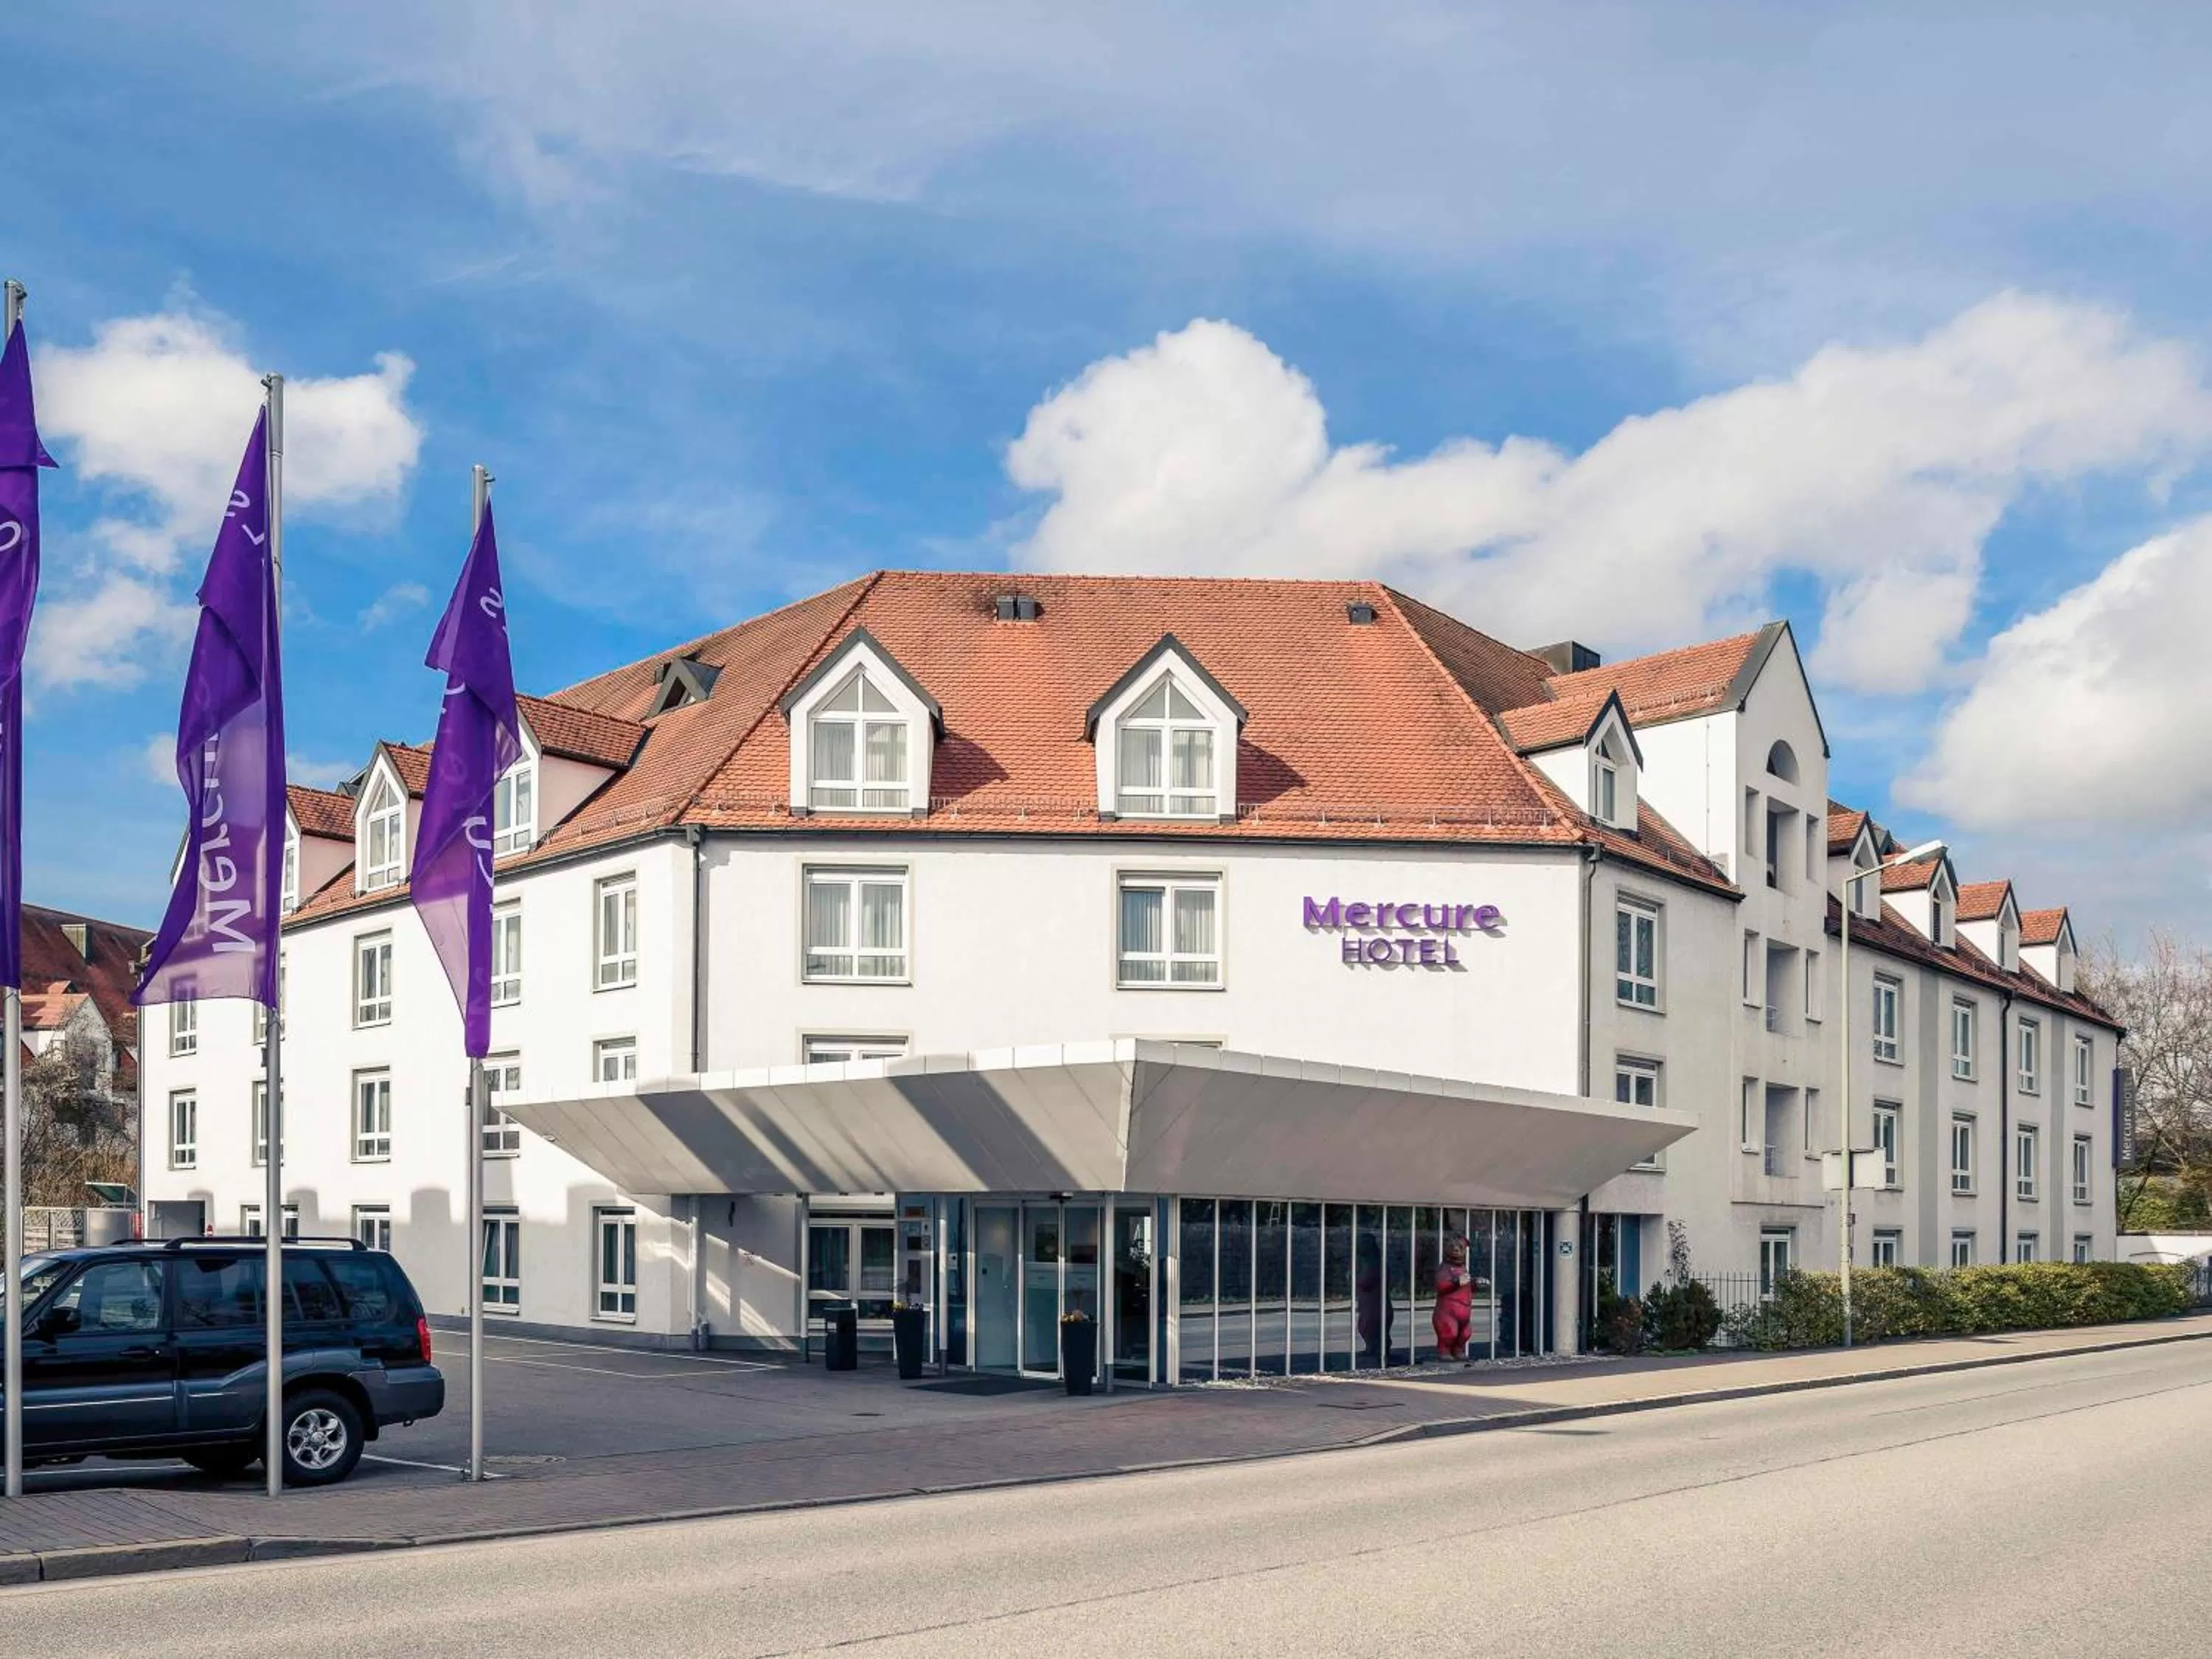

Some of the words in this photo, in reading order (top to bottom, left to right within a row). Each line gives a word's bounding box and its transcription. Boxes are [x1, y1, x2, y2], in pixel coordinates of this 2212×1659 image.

[1303, 896, 1501, 931] Mercure
[1341, 937, 1460, 964] HOTEL
[2123, 1109, 2132, 1161] Mercure
